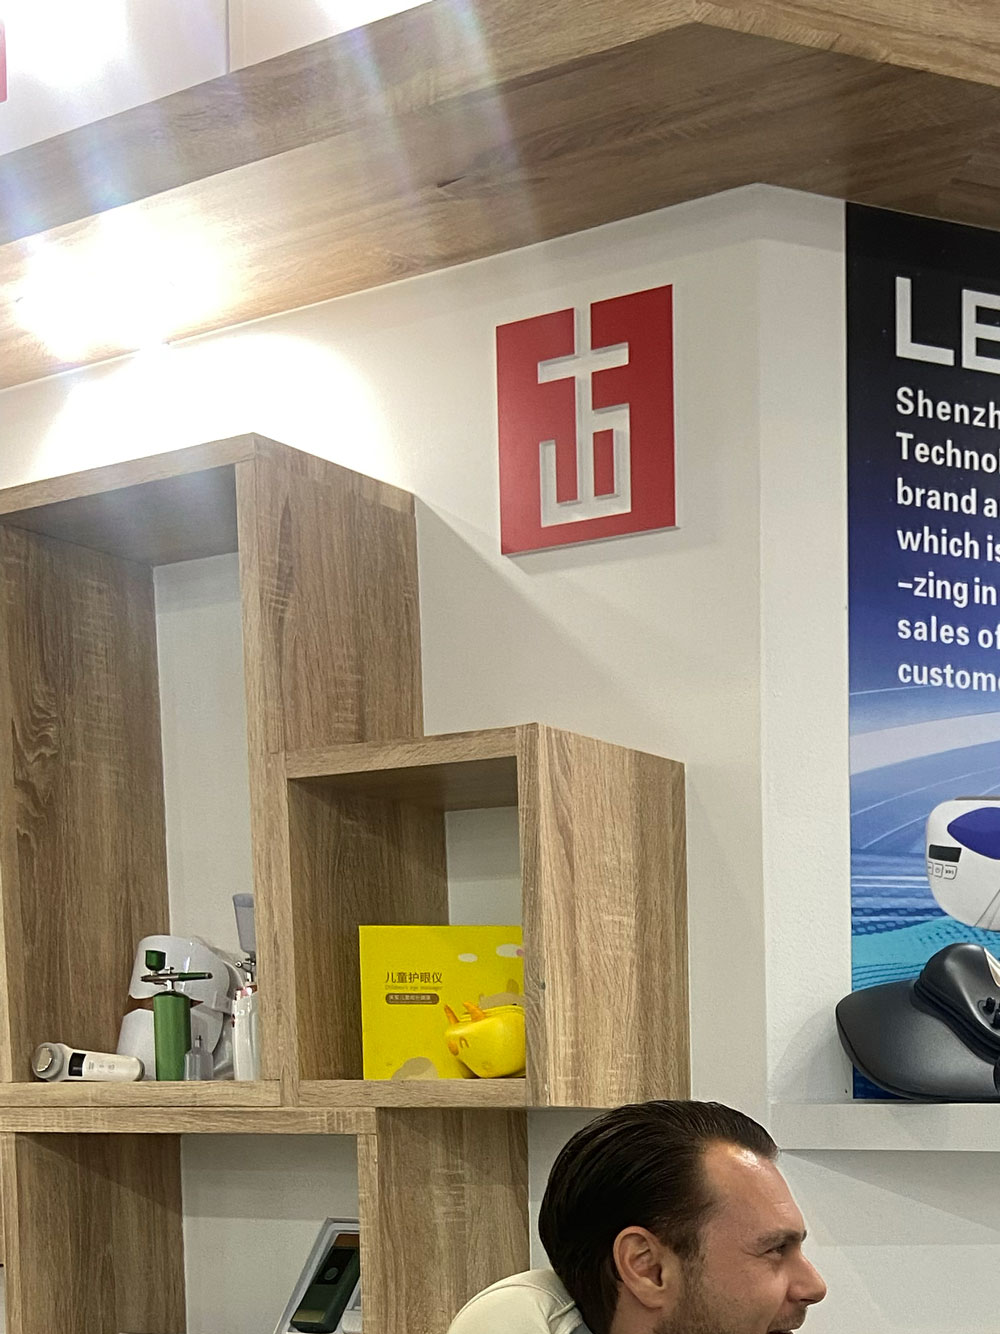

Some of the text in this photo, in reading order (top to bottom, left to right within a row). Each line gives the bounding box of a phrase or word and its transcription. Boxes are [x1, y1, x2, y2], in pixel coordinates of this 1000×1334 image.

[897, 478, 977, 515] brand
[897, 526, 979, 560] which
[974, 578, 997, 606] in
[898, 617, 969, 645] sales
[385, 972, 442, 984] 儿童护眼仪
